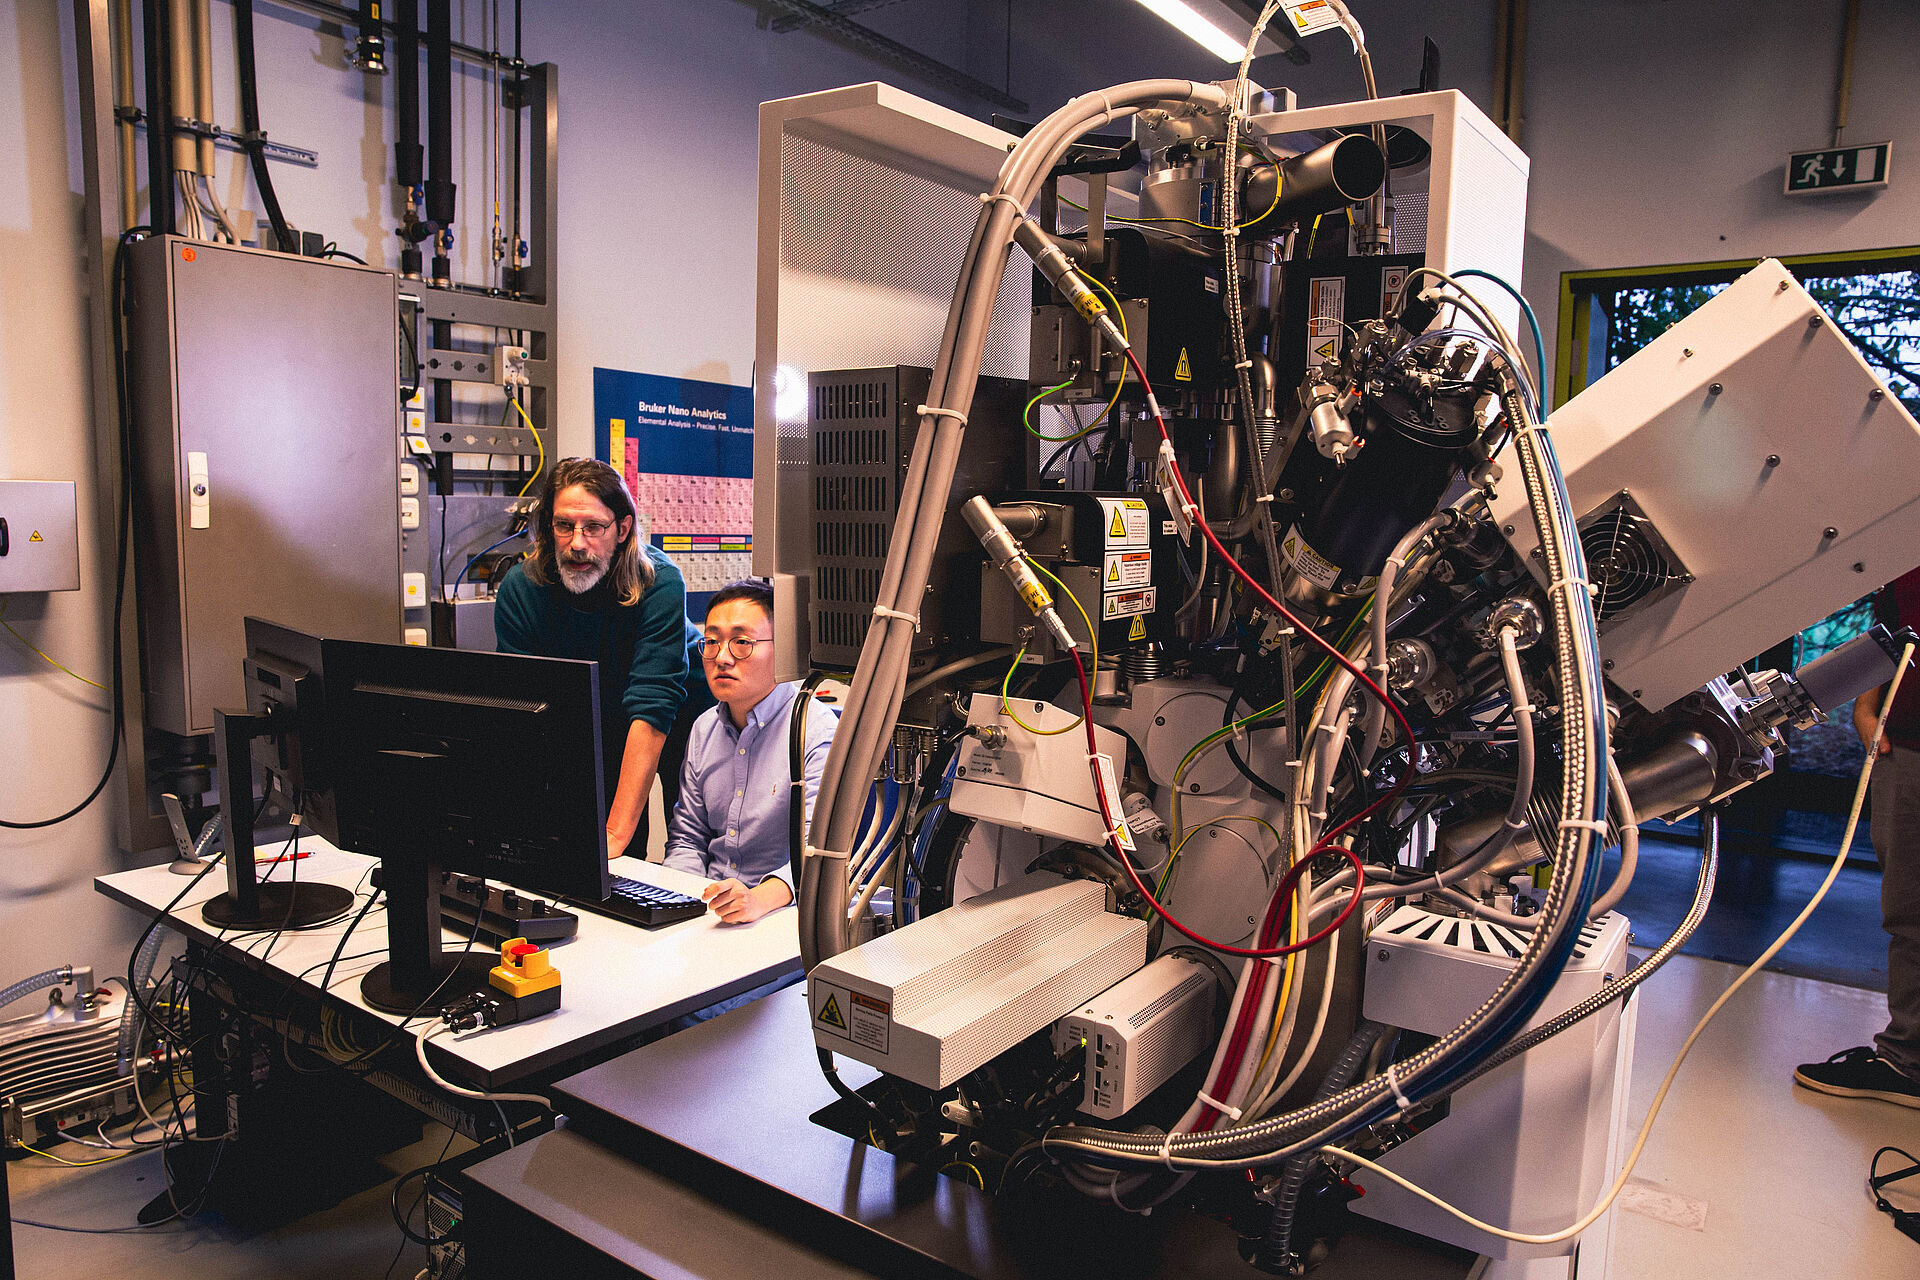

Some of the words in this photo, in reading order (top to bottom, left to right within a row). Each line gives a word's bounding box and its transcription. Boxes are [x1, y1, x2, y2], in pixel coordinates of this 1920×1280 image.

[638, 401, 666, 414] Bruker
[668, 404, 690, 416] Nano
[691, 407, 727, 420] Analytics
[638, 416, 667, 426] Elemental
[668, 419, 691, 429] Analysis
